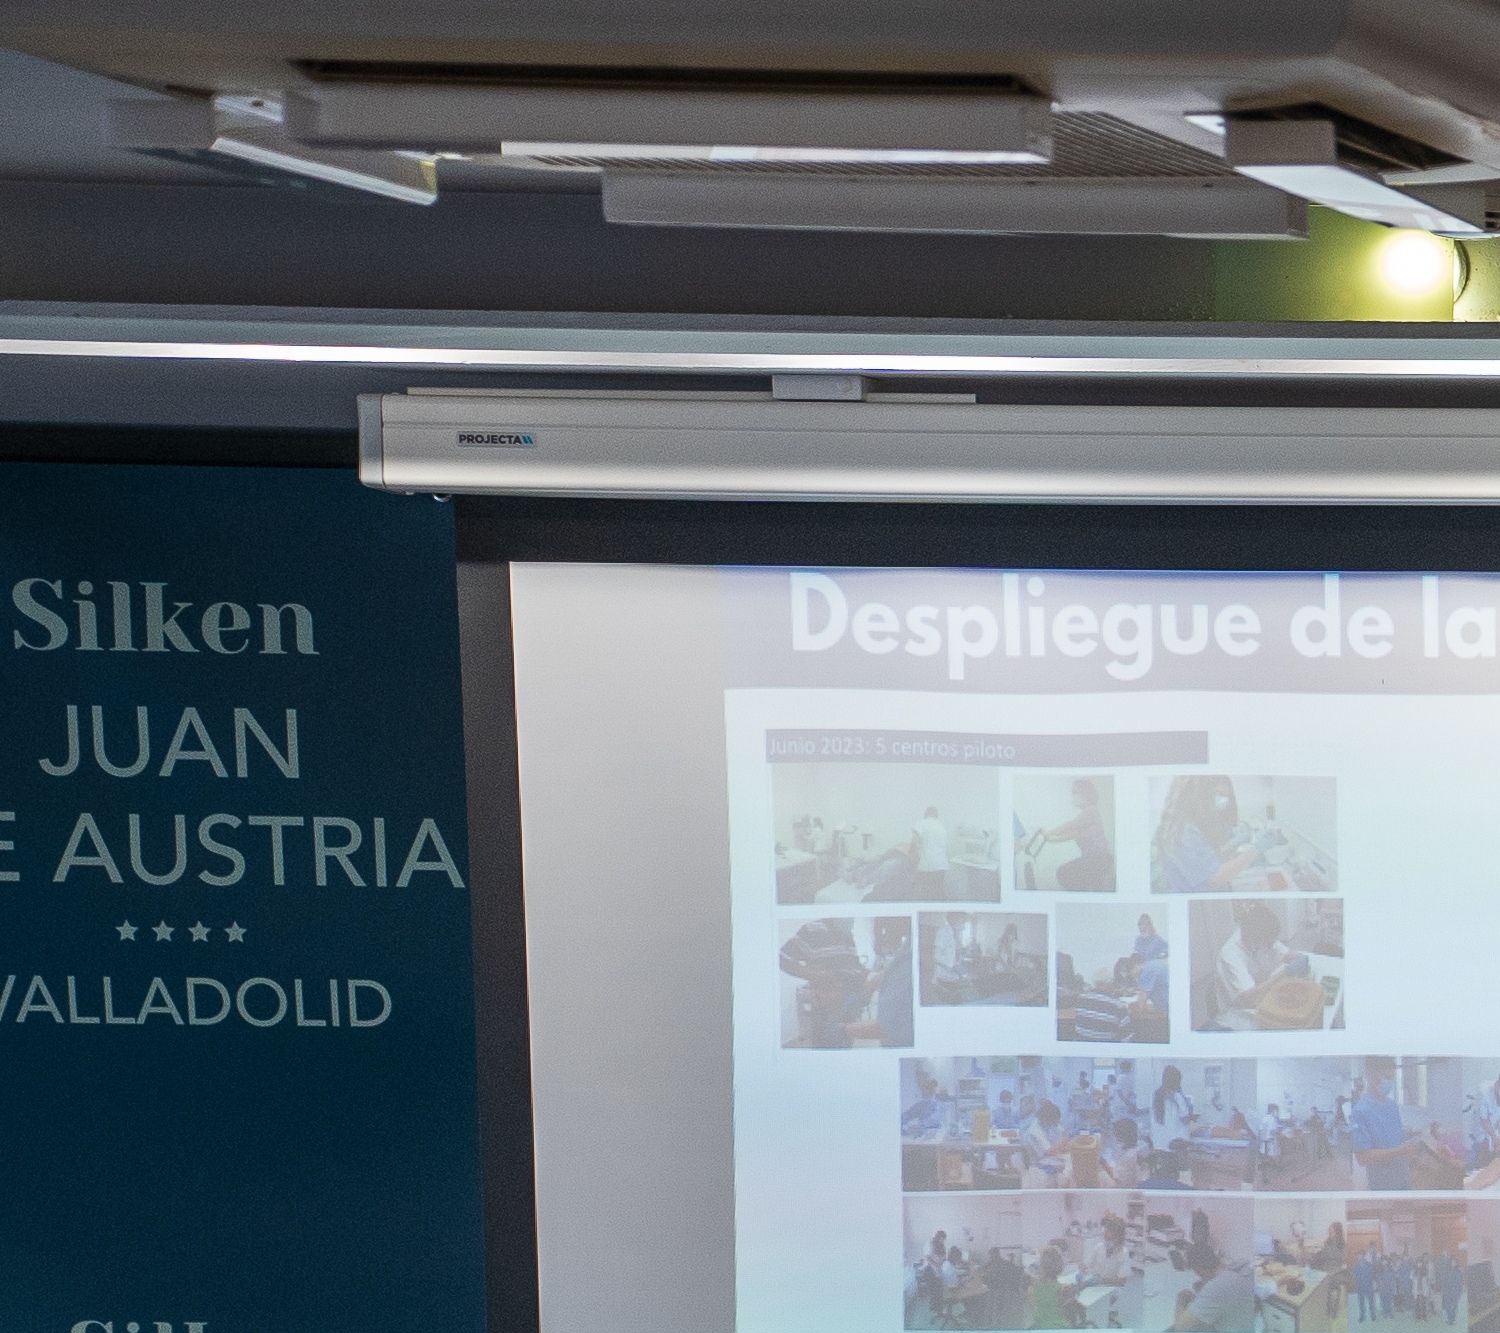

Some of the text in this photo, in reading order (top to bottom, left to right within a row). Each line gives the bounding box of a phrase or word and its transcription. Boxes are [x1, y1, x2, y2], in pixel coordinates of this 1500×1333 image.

[459, 434, 522, 445] PROJECTA
[12, 578, 320, 655] Silken
[791, 571, 1261, 680] Despliegue
[1290, 573, 1394, 658] de
[1421, 574, 1496, 658] la
[38, 704, 301, 780] JUAN
[770, 737, 816, 758] Junio
[891, 738, 958, 758] centros
[964, 738, 1016, 760] piloto
[54, 813, 466, 889] AUSTRIA
